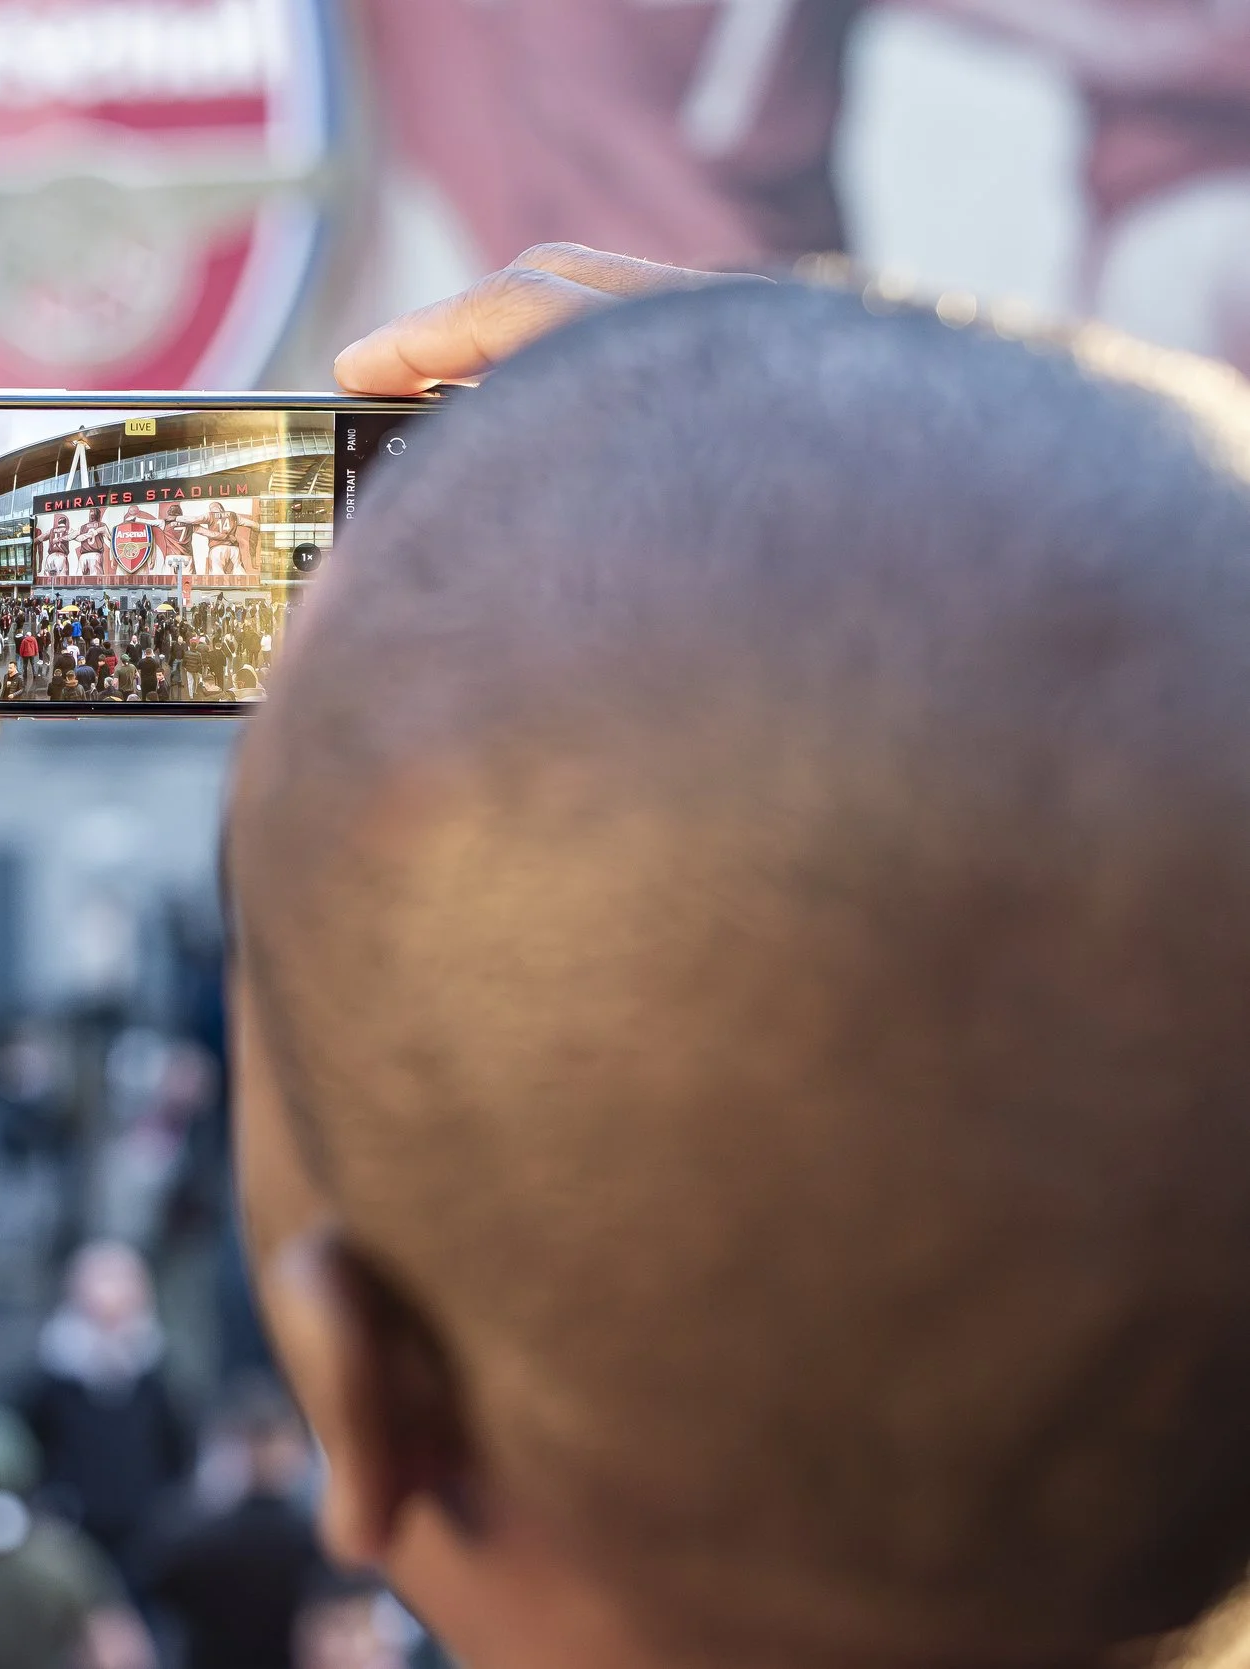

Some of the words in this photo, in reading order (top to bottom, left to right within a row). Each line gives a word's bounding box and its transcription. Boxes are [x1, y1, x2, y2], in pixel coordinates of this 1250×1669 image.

[130, 423, 152, 431] LIVE
[347, 428, 356, 451] PANO
[44, 492, 132, 512] EMIRATES
[146, 483, 248, 501] STADIUM
[346, 469, 356, 520] PORTRAIT
[117, 530, 147, 538] Arsenal
[173, 526, 187, 542] 7
[216, 519, 230, 533] 14
